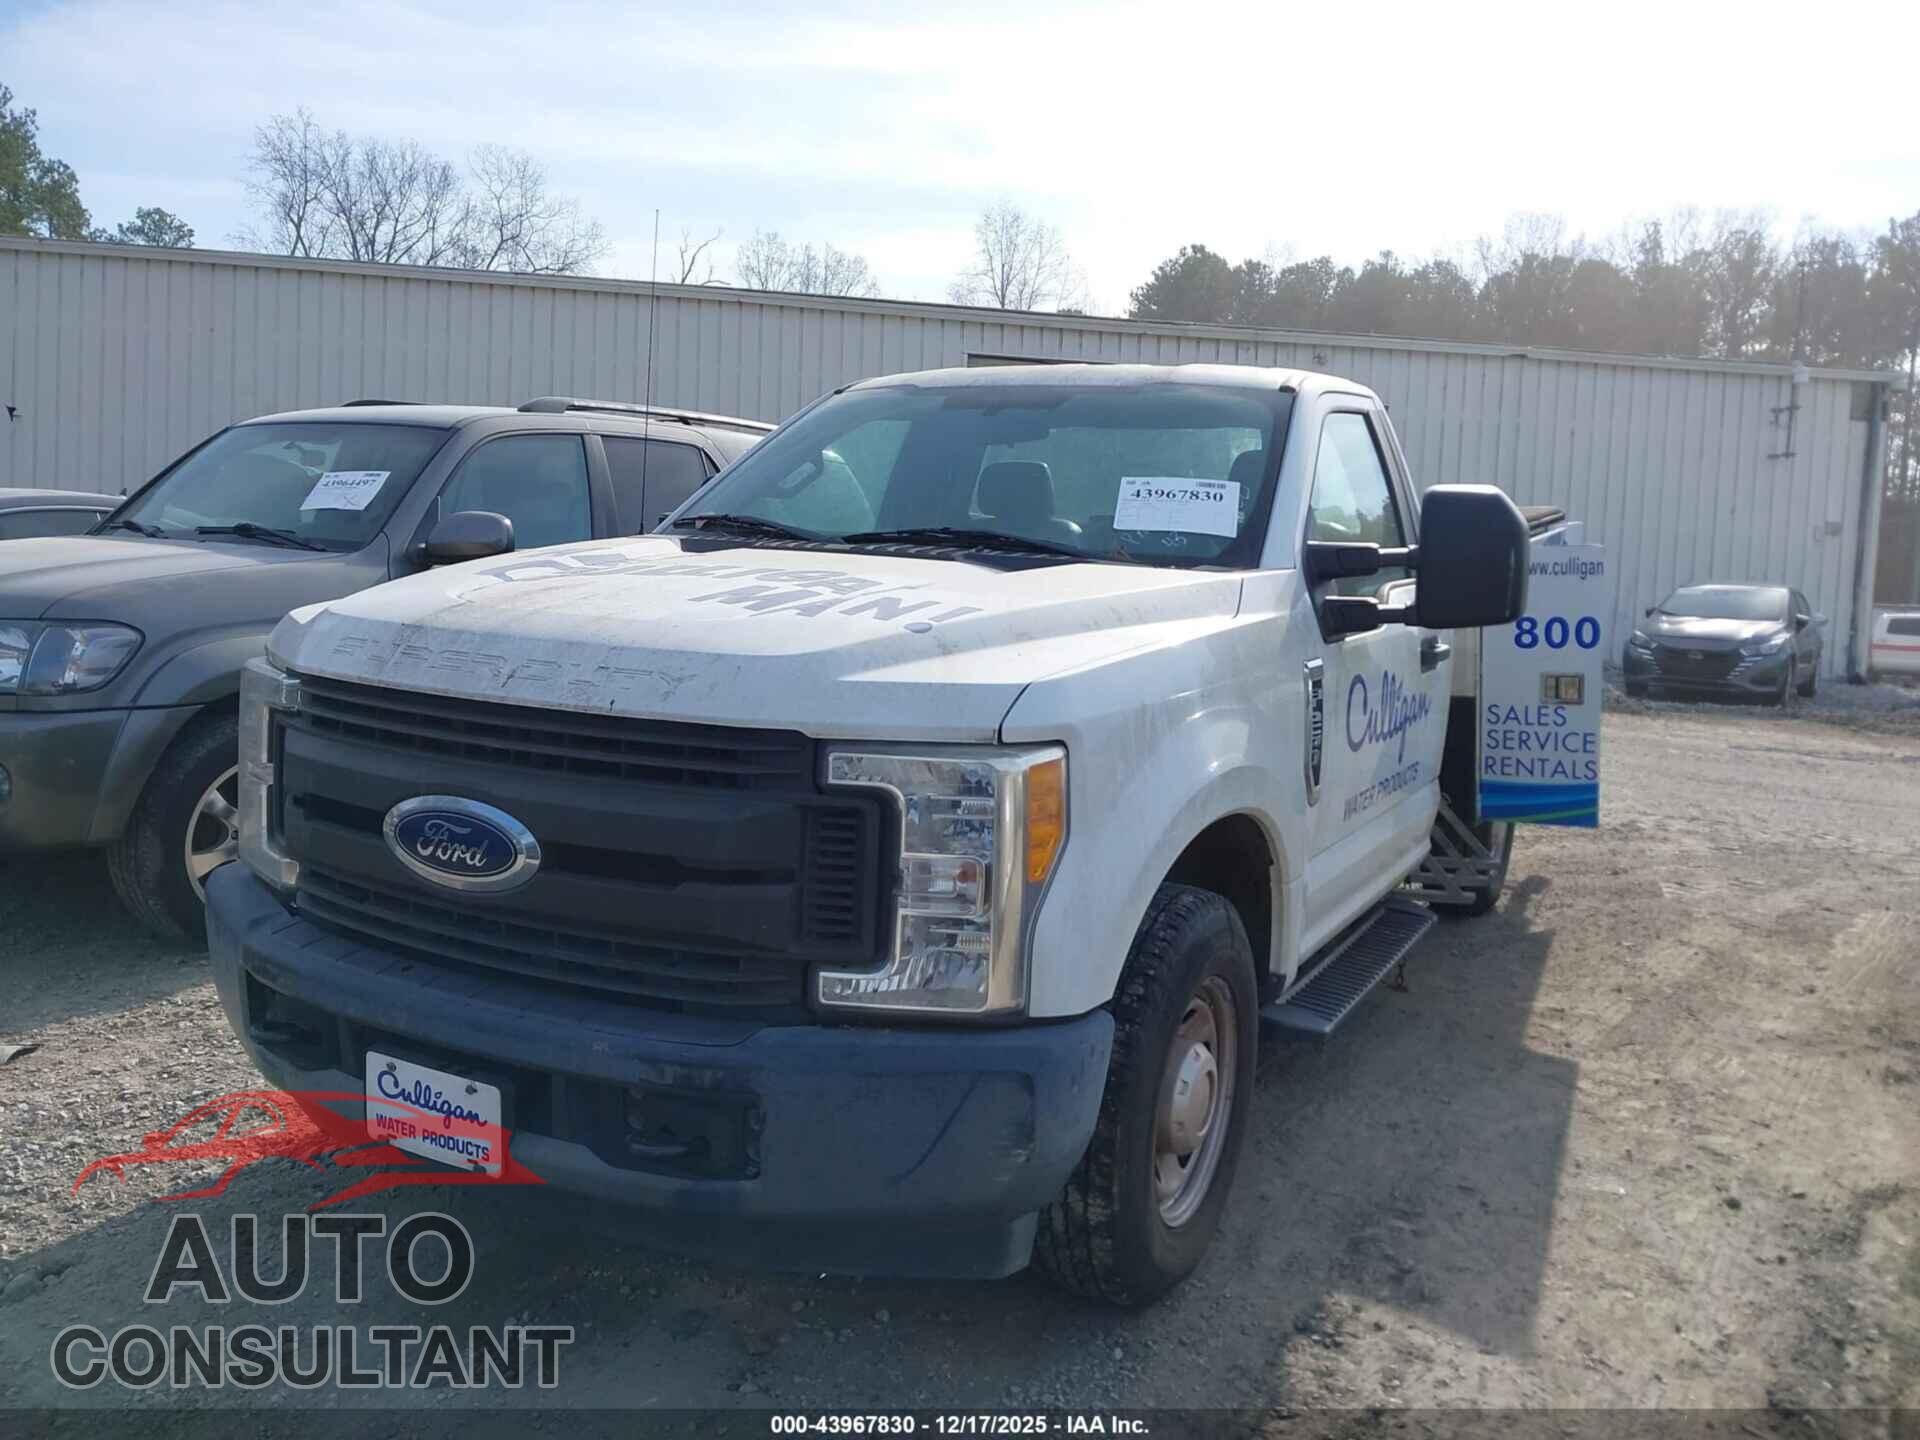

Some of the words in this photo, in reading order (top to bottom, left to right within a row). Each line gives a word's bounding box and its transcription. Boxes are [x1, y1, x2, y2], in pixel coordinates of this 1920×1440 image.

[1130, 487, 1224, 502] 43967830
[1514, 616, 1601, 650] 800
[1346, 669, 1432, 766] Culligan
[1487, 704, 1567, 727] SALES
[1486, 730, 1596, 753] SERVICE
[1485, 756, 1598, 780] RENTALS
[416, 820, 489, 867] Ford
[377, 1069, 488, 1130] Culligan
[376, 1113, 417, 1139] WATER
[421, 1129, 490, 1162] PRODUCTS
